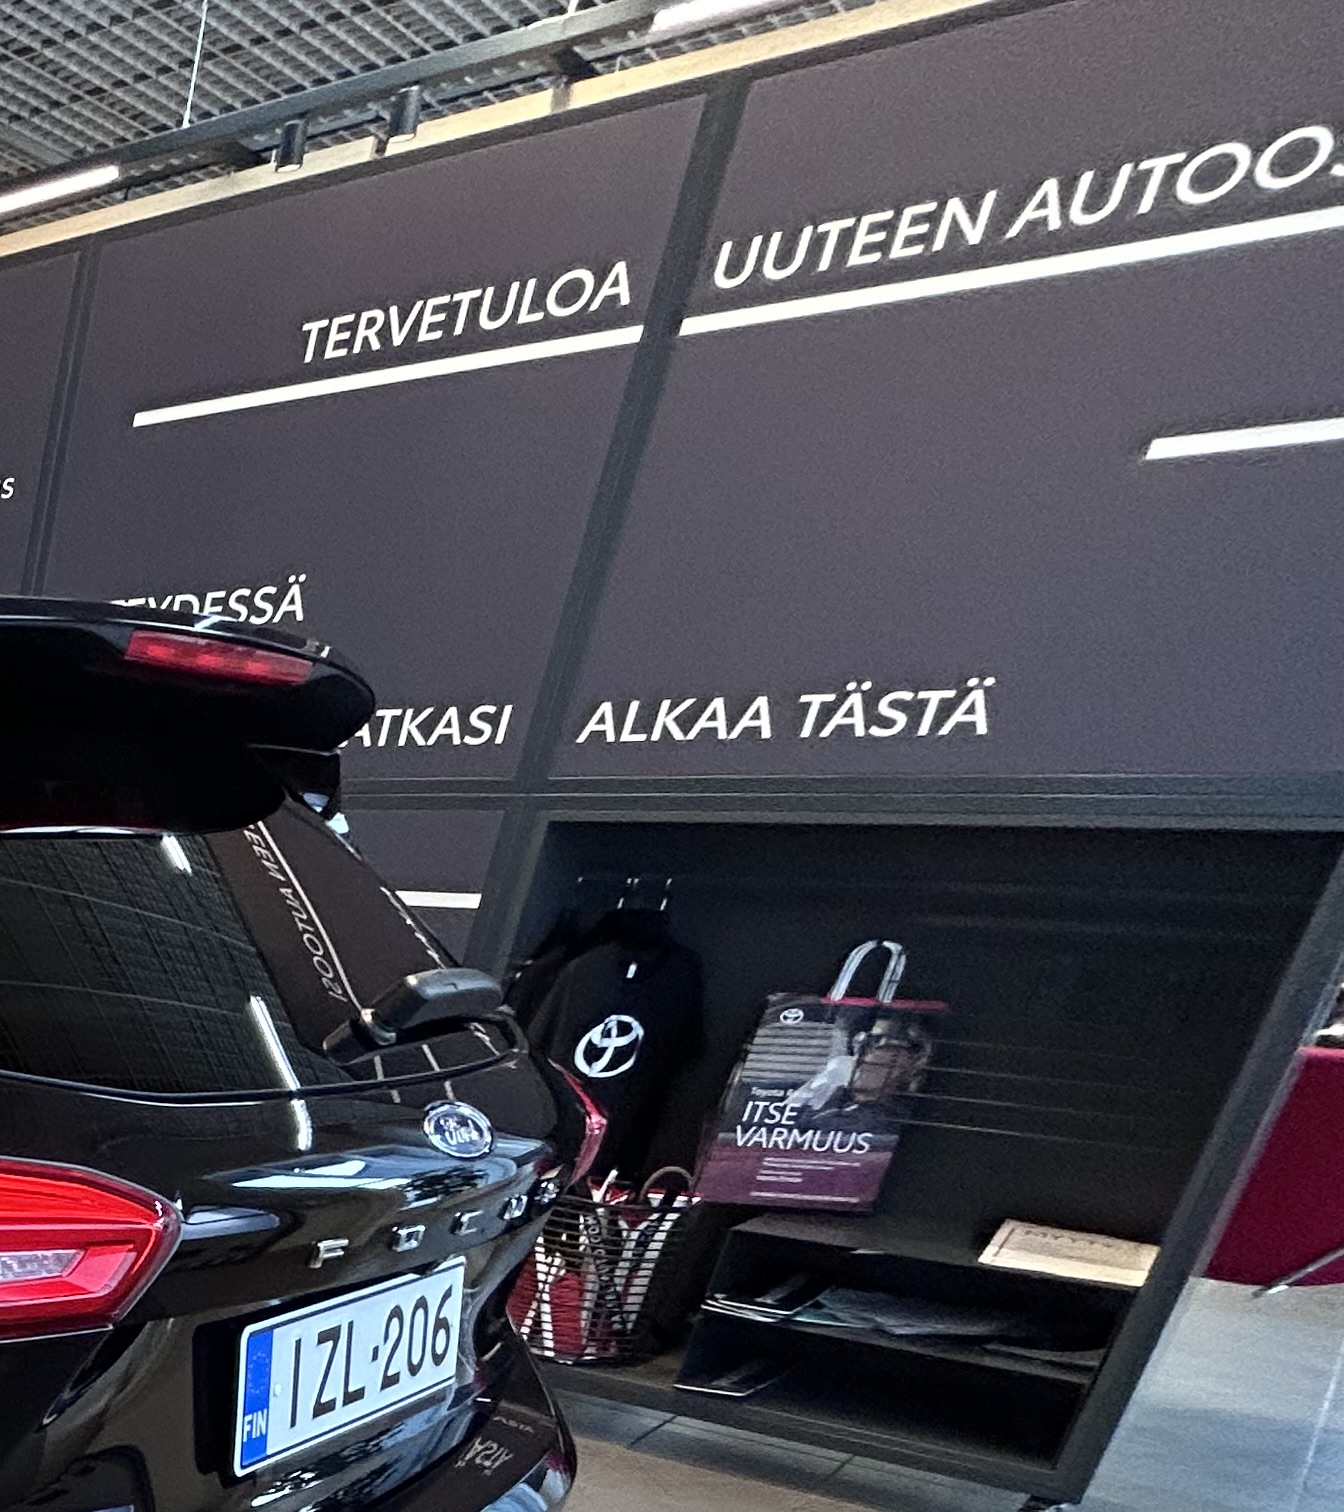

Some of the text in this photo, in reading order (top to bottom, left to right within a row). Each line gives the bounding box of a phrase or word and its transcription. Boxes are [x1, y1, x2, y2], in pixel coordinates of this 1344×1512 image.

[302, 260, 631, 364] TERVETULOA
[714, 188, 999, 289] UUTEEN
[575, 695, 772, 744] ALKAA
[798, 676, 997, 738] TÄSTÄ
[741, 1100, 802, 1126] ITSE
[736, 1124, 875, 1155] VARMUUS
[288, 1284, 453, 1430] IZL-206
[243, 1408, 268, 1443] FIN
